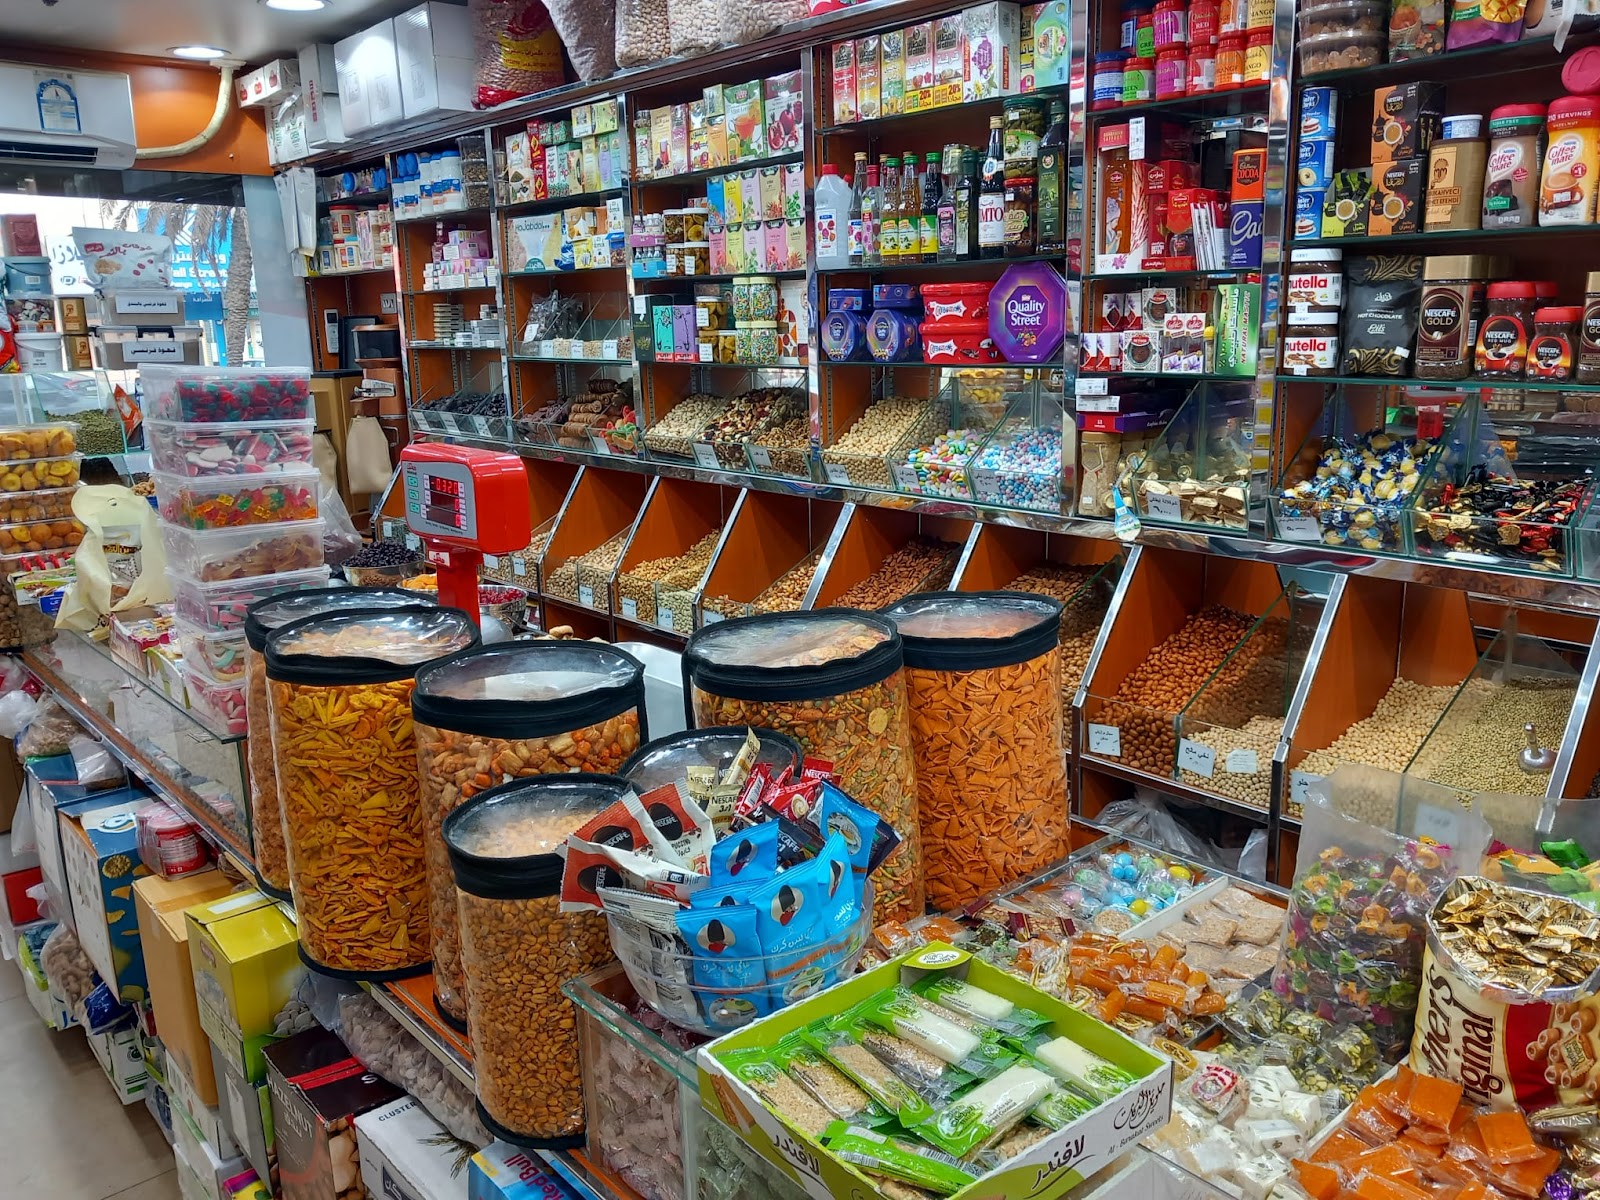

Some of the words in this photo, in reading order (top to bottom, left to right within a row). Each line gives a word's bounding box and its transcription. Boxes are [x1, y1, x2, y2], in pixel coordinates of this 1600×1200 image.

[919, 90, 931, 100] 20%
[948, 84, 961, 95] 20%
[1557, 111, 1592, 120] SERVINGS
[1548, 145, 1577, 161] Coffee
[1551, 153, 1574, 166] mate
[1489, 153, 1516, 168] Coffee
[1491, 161, 1512, 173] mate
[1238, 169, 1259, 179] COCOA
[1007, 300, 1045, 316] Quality
[1010, 315, 1042, 326] Street
[1426, 317, 1454, 326] GOLD
[1240, 326, 1249, 365] NATURAL
[907, 1026, 928, 1040] Coconut
[1450, 1000, 1505, 1106] riginal
[1144, 1115, 1164, 1132] Sweets
[503, 1153, 541, 1182] Bull
[1031, 1135, 1086, 1190] لافندر
